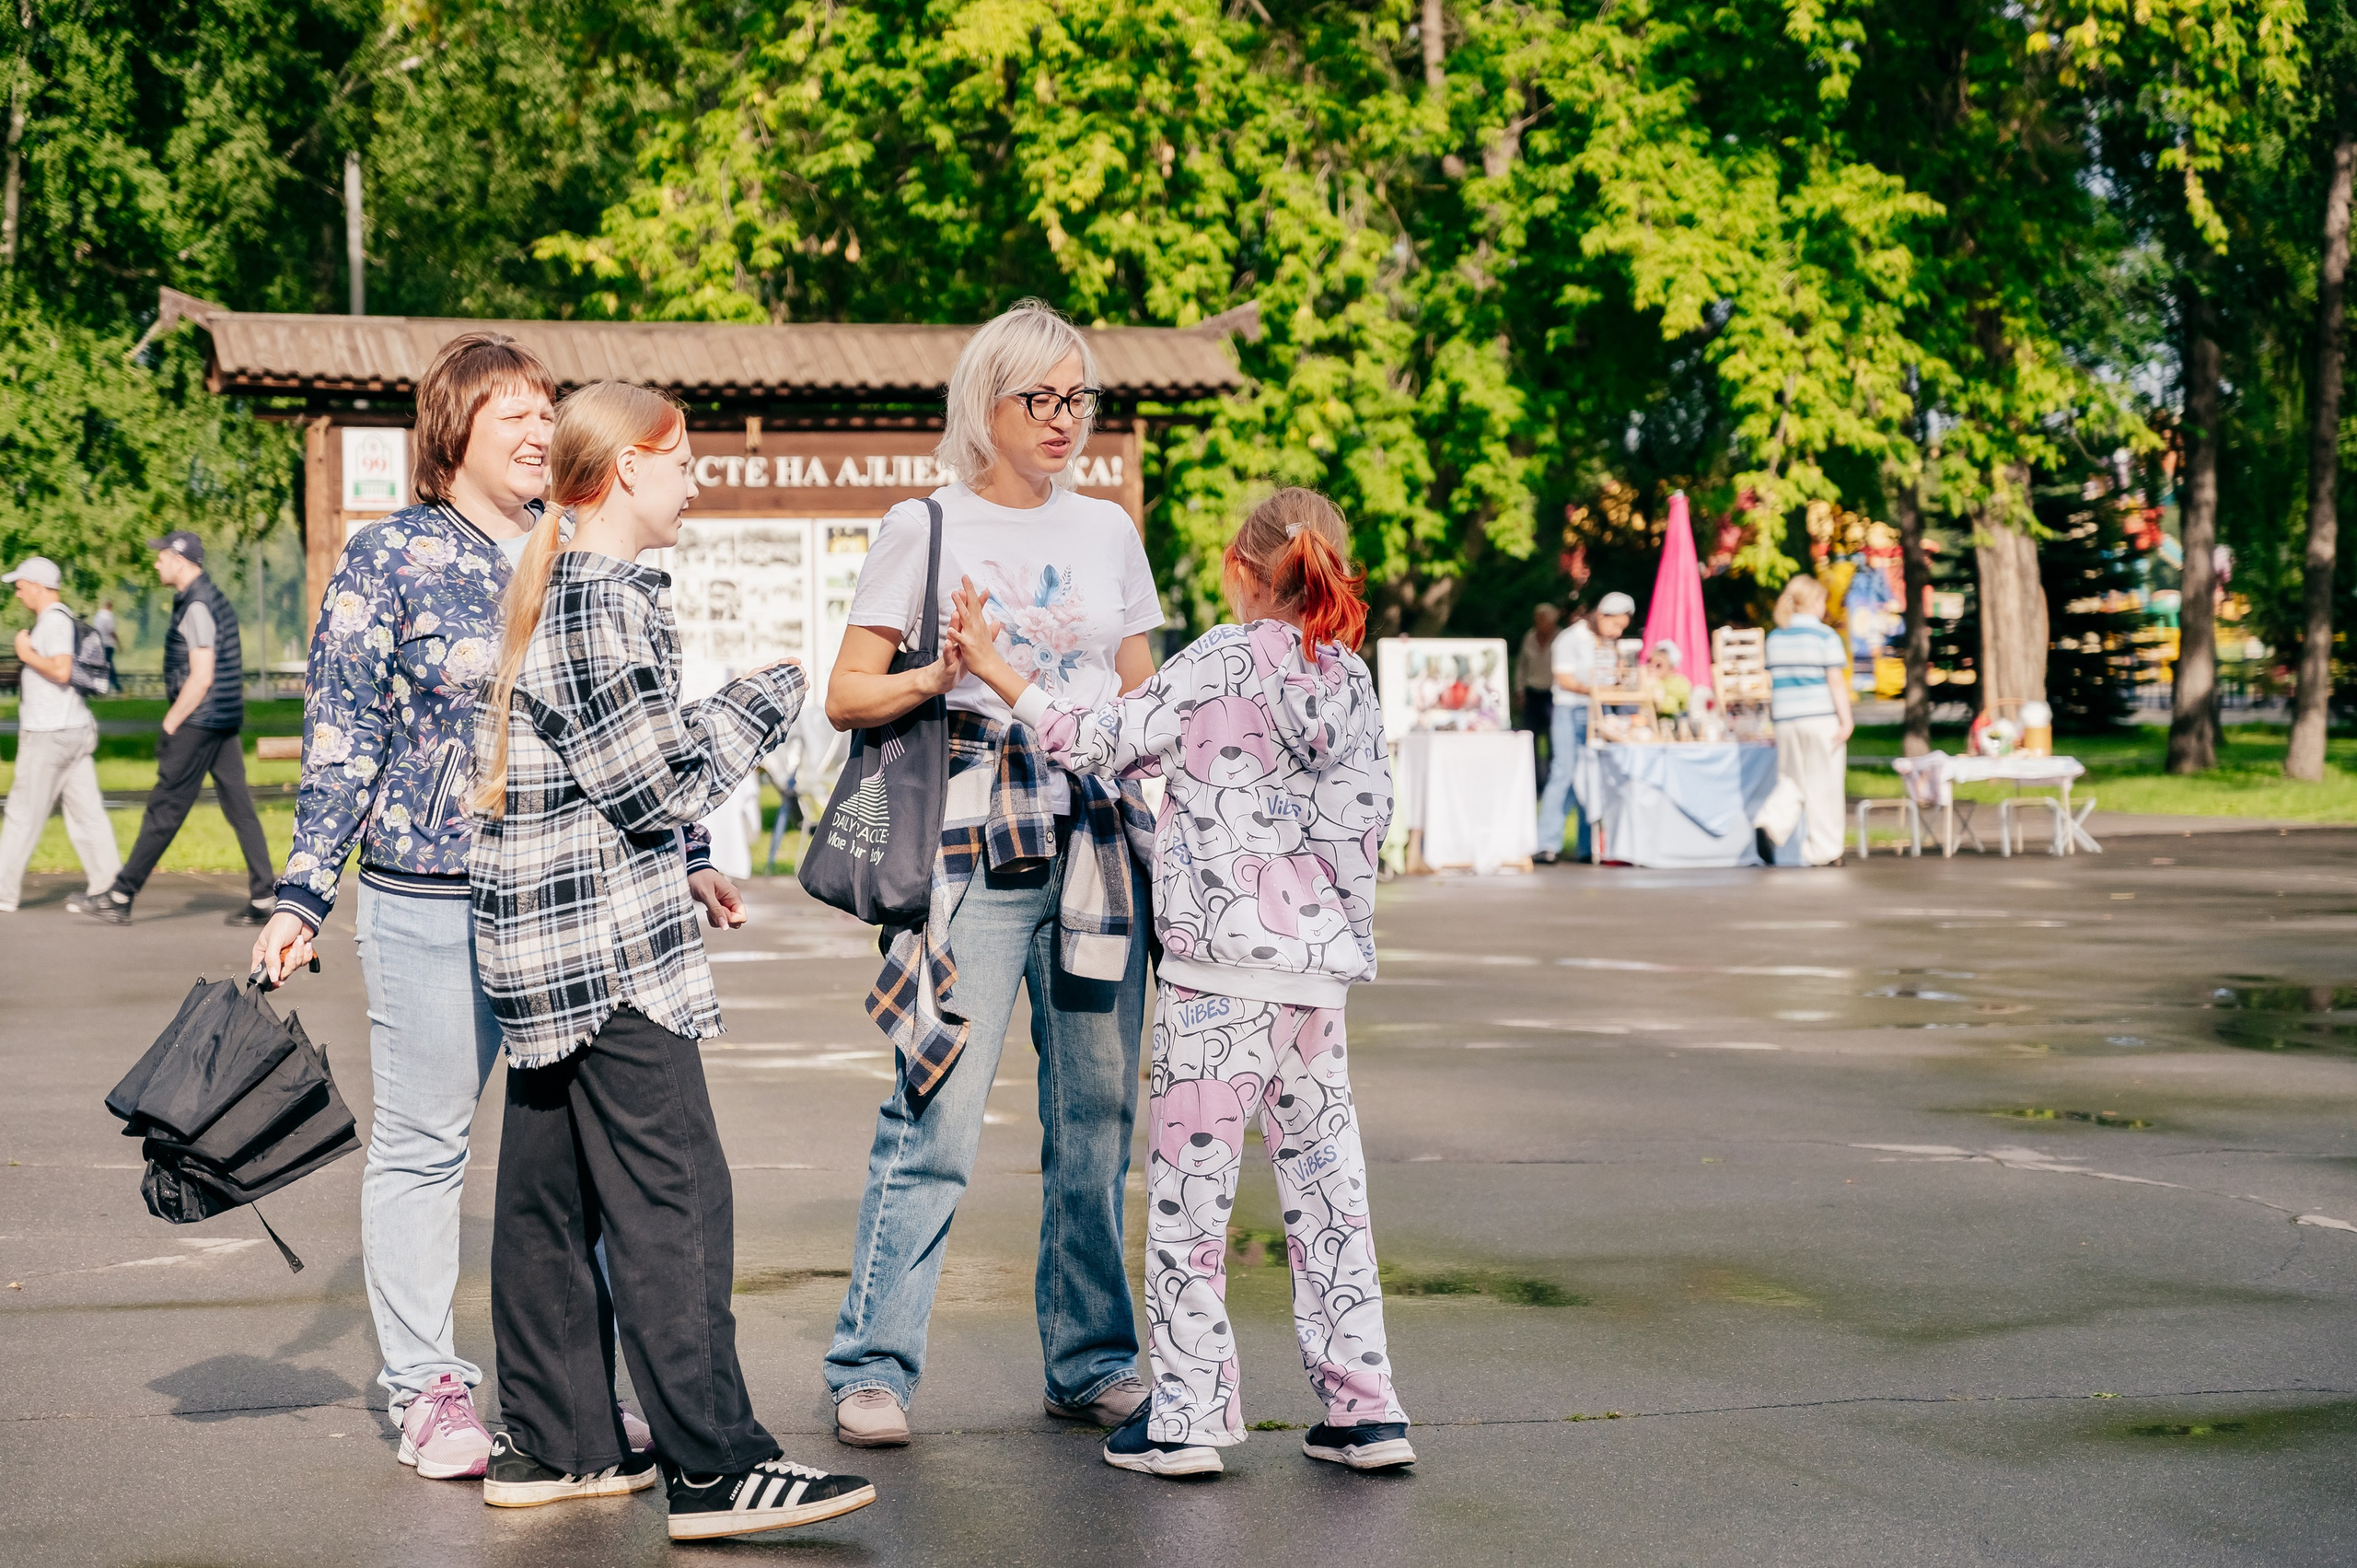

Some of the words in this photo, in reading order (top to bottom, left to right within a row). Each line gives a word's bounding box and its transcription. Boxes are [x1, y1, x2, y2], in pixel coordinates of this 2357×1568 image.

[686, 455, 770, 488] СТЕ
[773, 455, 830, 488] НА
[729, 1480, 743, 1501] CAMPUS
